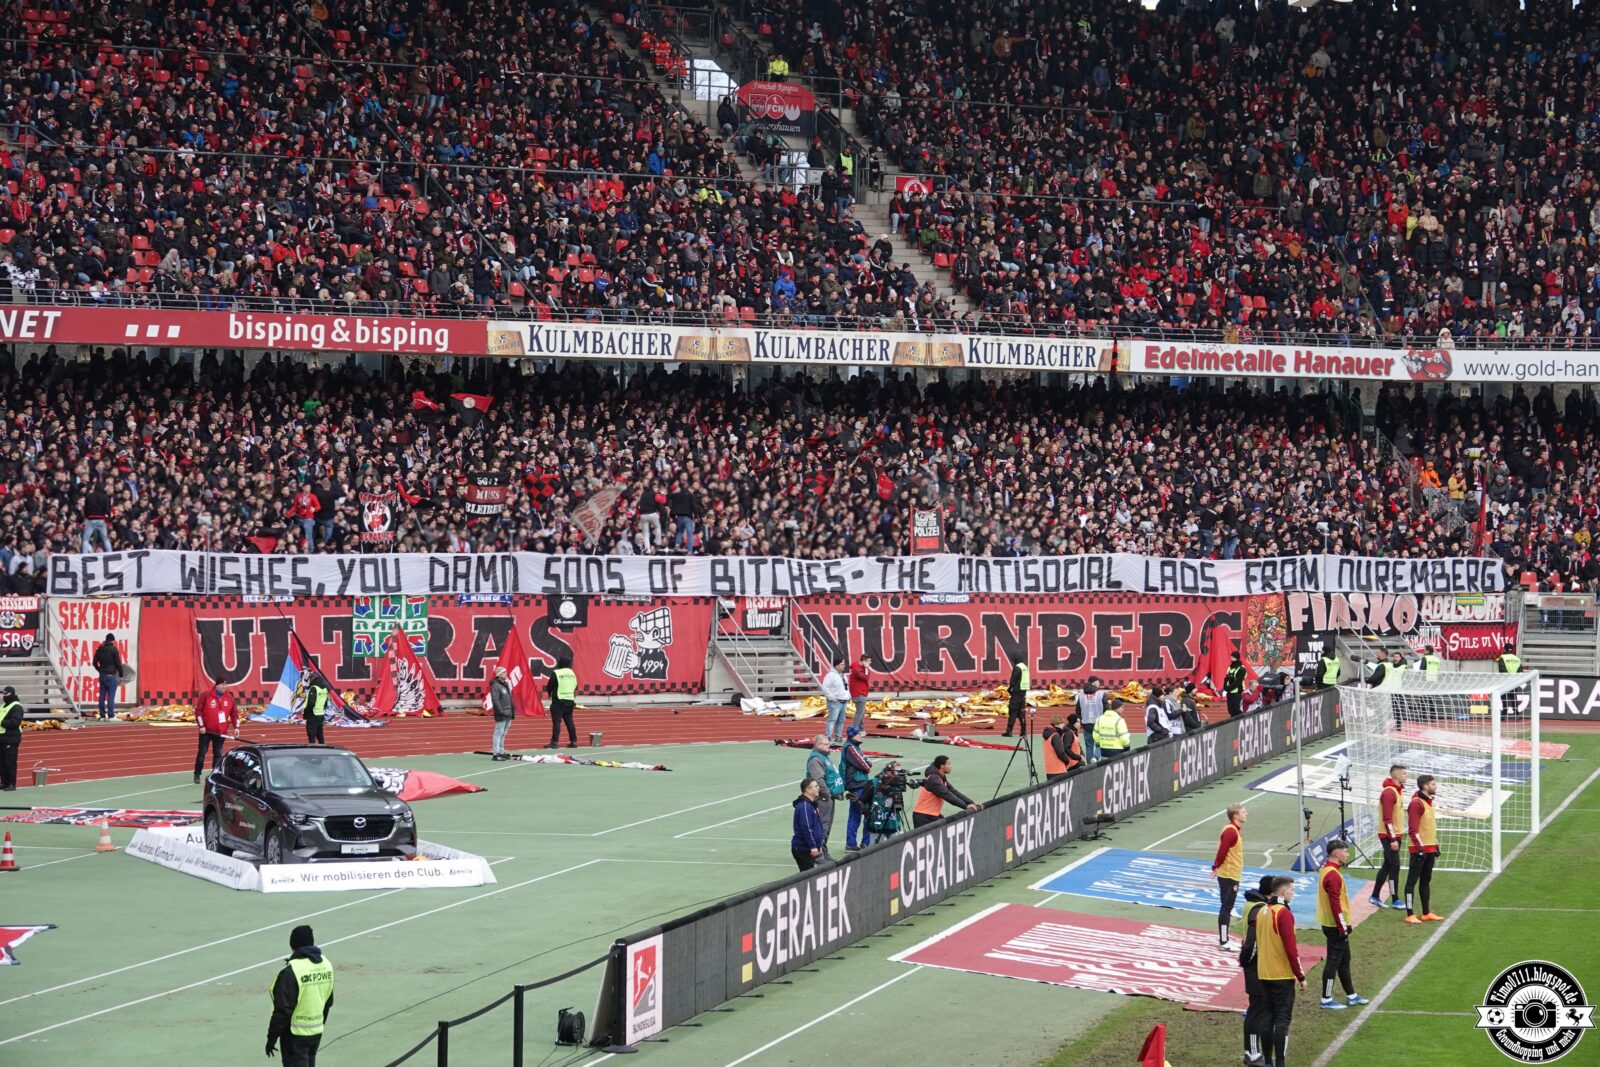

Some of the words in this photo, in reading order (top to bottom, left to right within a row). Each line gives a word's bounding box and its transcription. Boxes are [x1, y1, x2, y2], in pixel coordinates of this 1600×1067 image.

[767, 104, 784, 113] FCN
[229, 314, 325, 347] bisping
[331, 318, 351, 343] &
[355, 318, 449, 352] bisping
[528, 325, 673, 356] KULMBACHER
[754, 331, 891, 362] KULMBACHER
[967, 337, 1097, 368] KULMBACHER
[1144, 345, 1286, 373] Edelmetalle
[1294, 350, 1394, 377] Hanauer
[1464, 358, 1599, 380] www.gold-han
[913, 526, 940, 537] POLIZEI
[51, 550, 151, 595] BEST
[336, 557, 401, 595] YOU
[541, 556, 625, 595] SONS
[649, 558, 686, 593] OF
[876, 557, 936, 591] THE
[1245, 557, 1320, 594] FROM
[1337, 558, 1498, 593] NUREMBERG
[0, 595, 38, 611] SESSENEN
[58, 600, 130, 631] SEKTION
[1287, 592, 1418, 633] FIASKO
[0, 631, 21, 648] SR
[796, 595, 1242, 678] NÜRNBERG
[58, 638, 129, 668] STAN
[641, 658, 665, 674] 1994
[1290, 695, 1324, 744] GRATEK
[1237, 711, 1273, 764] GERATEK
[1178, 731, 1218, 788] GERATEK
[1102, 751, 1151, 815] GERATEK
[1014, 779, 1074, 857] GERATEK
[300, 872, 320, 882] Wir
[323, 869, 391, 882] mobilisieren
[394, 868, 414, 879] den
[900, 817, 975, 909] GERATEK
[755, 866, 852, 974] GERATEK
[632, 1017, 656, 1035] BUNDESLIGA
